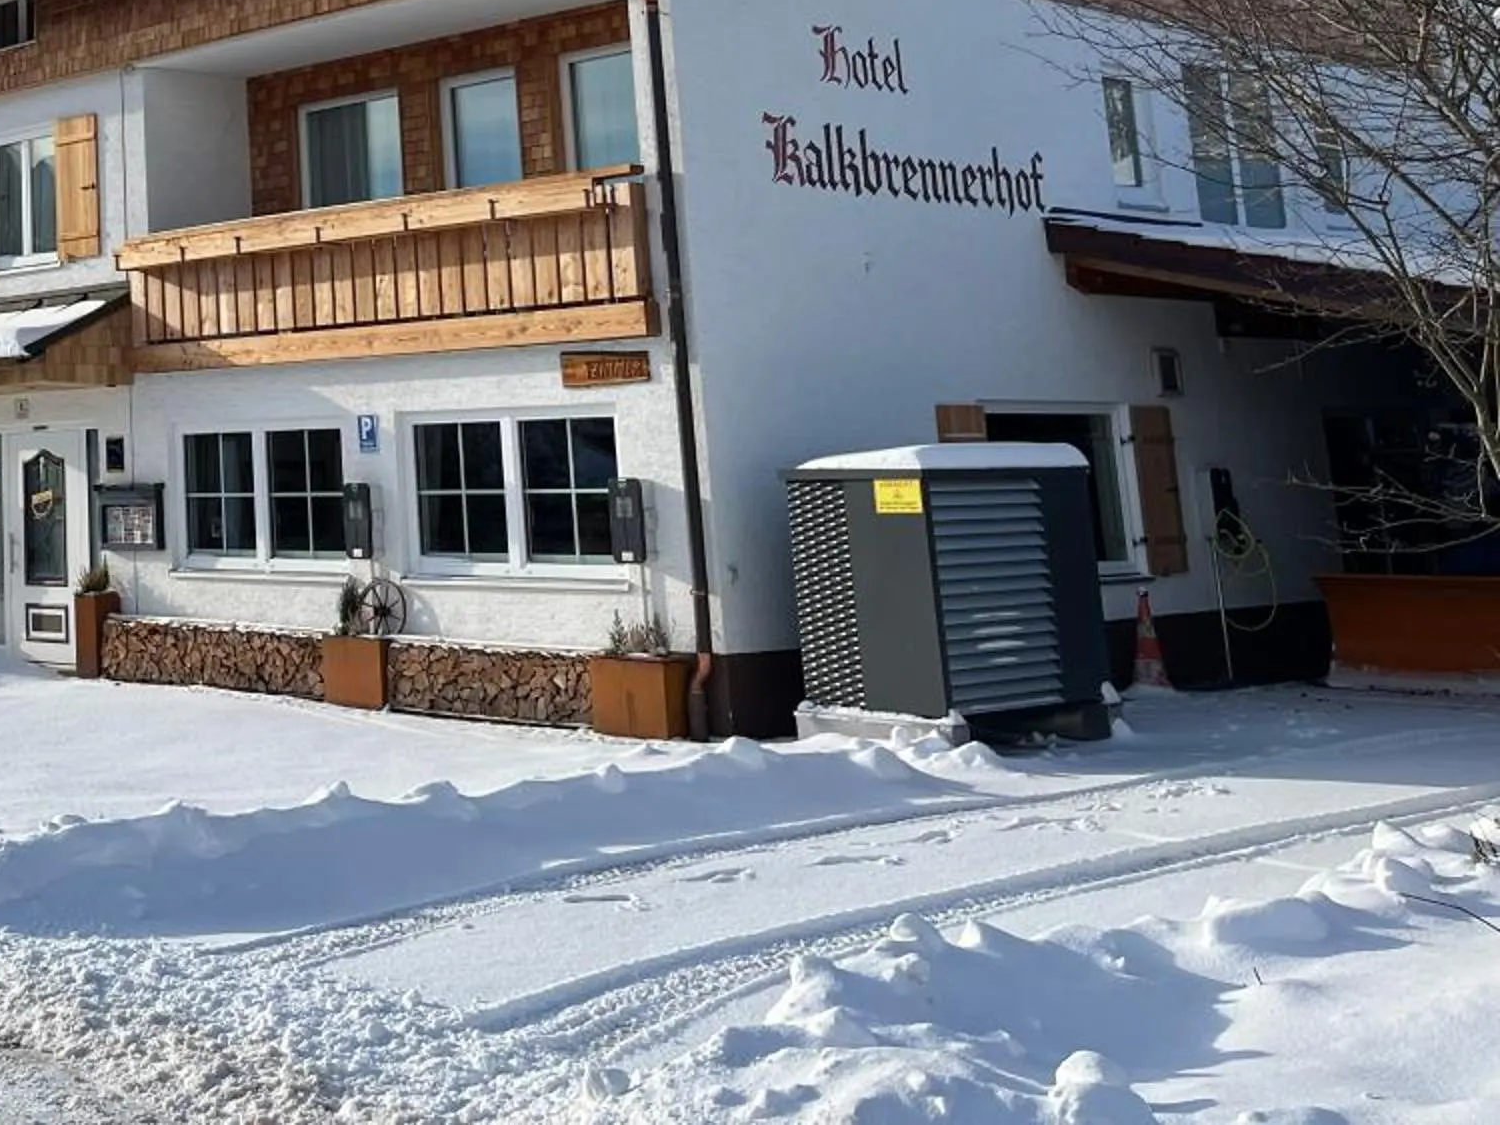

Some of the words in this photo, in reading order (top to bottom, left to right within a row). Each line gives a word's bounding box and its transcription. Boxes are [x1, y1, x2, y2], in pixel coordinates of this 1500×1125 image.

[812, 25, 909, 95] Hotel
[761, 110, 1046, 219] Kalkbrennerhof
[361, 416, 373, 440] P
